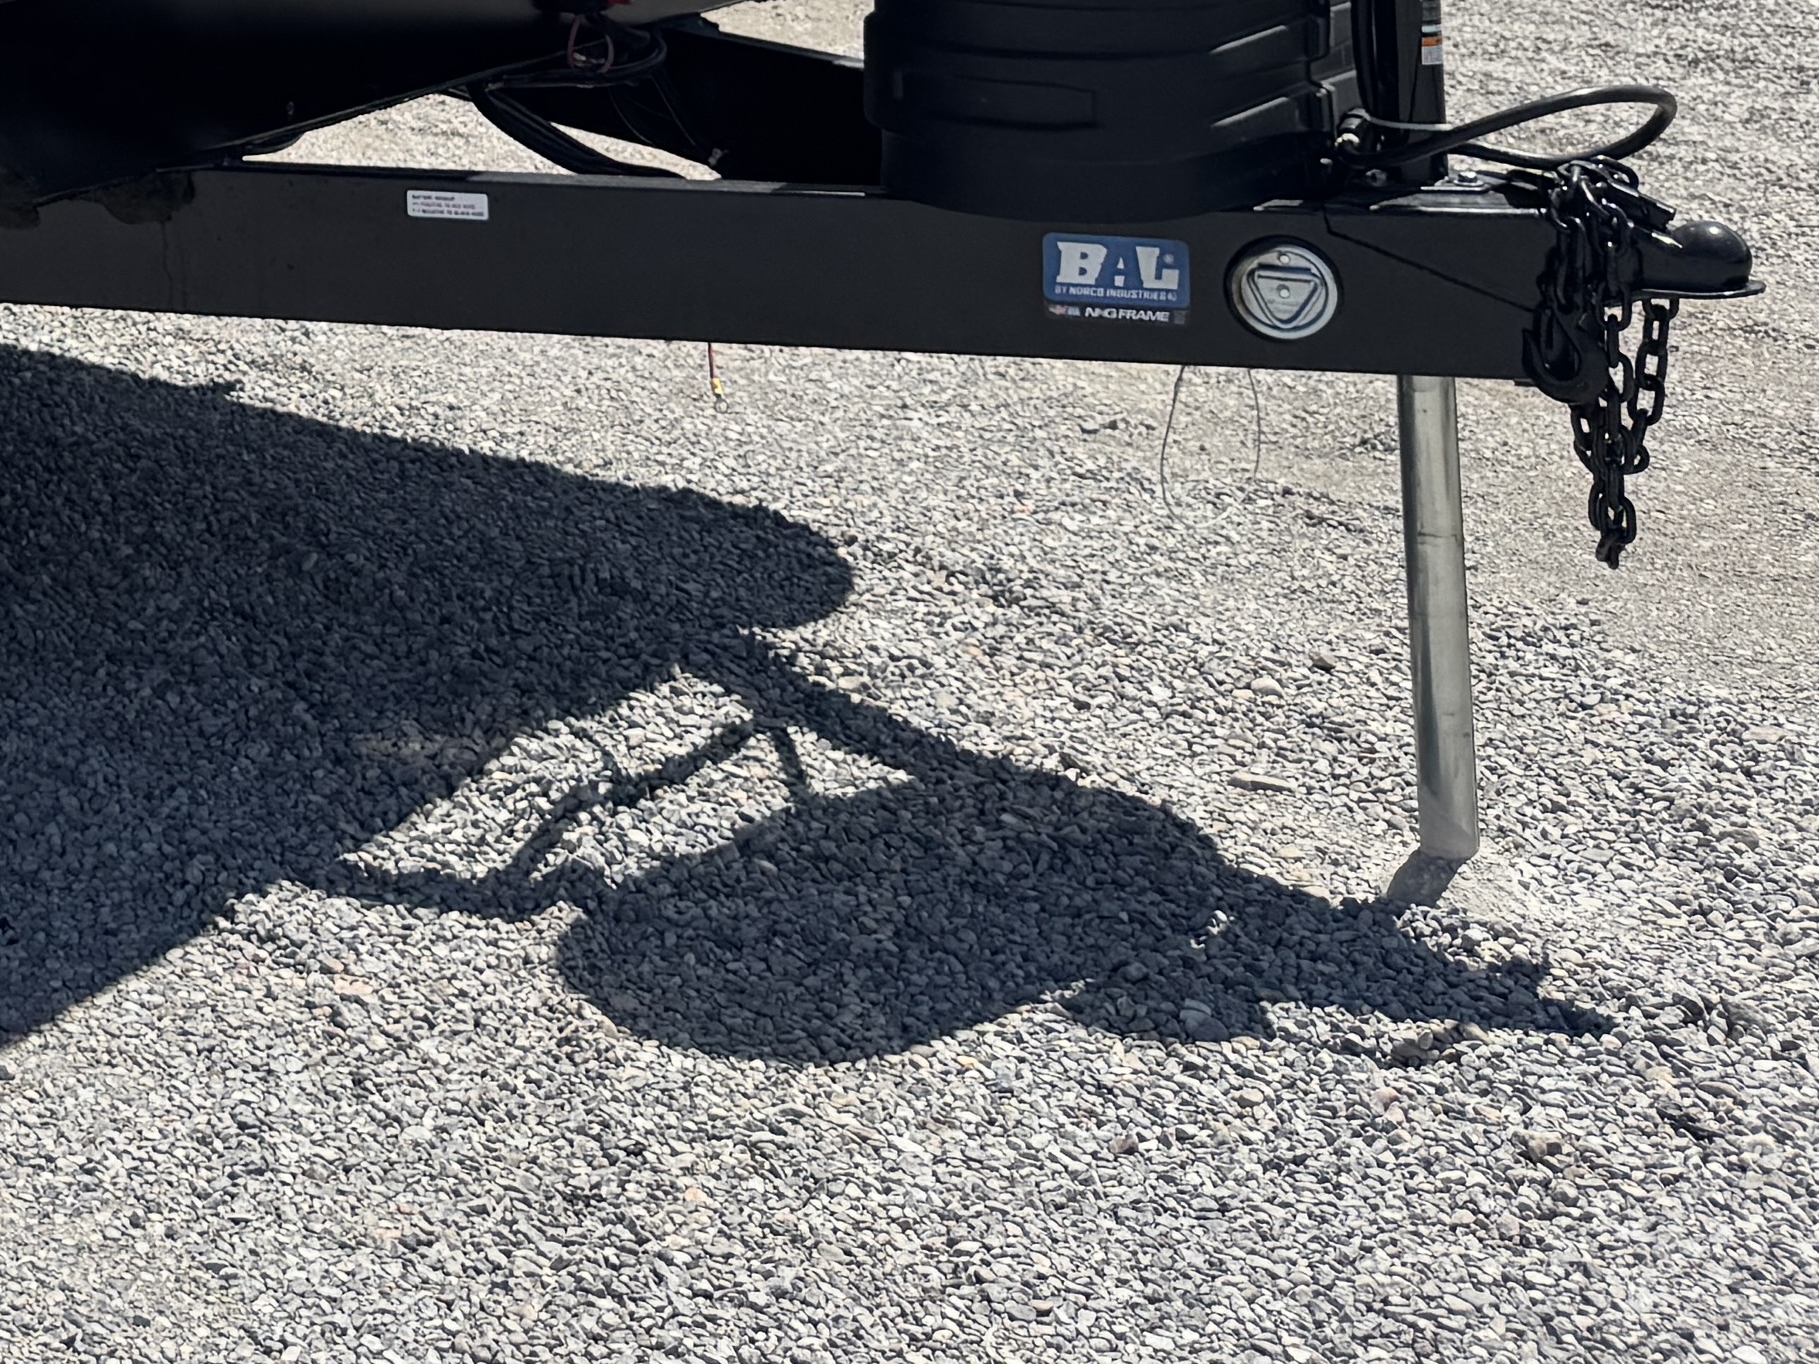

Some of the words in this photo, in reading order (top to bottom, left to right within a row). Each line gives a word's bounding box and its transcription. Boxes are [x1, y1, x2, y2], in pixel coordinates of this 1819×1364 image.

[1056, 240, 1180, 290] BAL
[1054, 284, 1067, 295] BY
[1068, 285, 1104, 297] NORCO
[1105, 287, 1166, 301] INDUSTRIES
